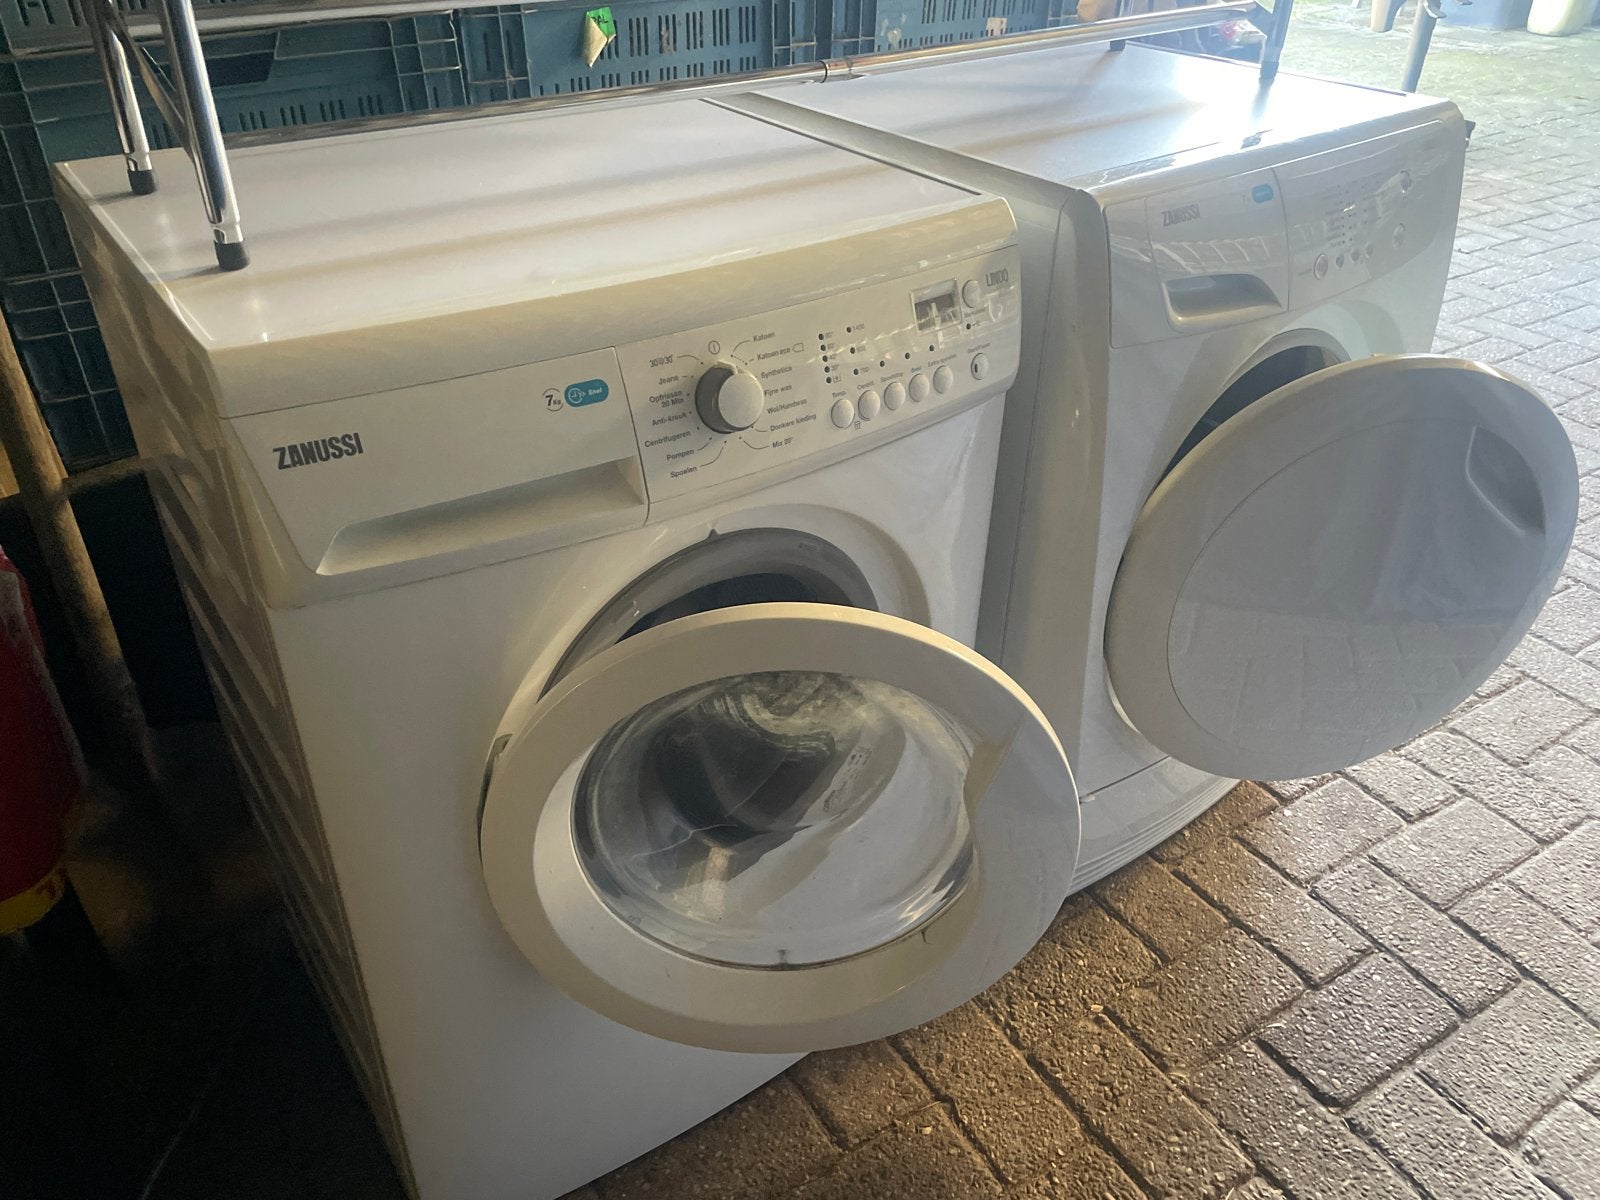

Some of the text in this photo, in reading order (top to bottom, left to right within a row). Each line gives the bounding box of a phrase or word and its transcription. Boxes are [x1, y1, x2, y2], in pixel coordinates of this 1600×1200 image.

[1160, 202, 1201, 227] ZANUSSI
[985, 267, 1010, 287] LINDO
[753, 331, 776, 342] Katoen
[757, 346, 791, 361] Katoen eco
[658, 375, 679, 385] Jeans
[780, 384, 793, 392] was
[769, 419, 795, 432] Donkere
[644, 430, 691, 448] Centrifugeren
[772, 440, 783, 448] Mix
[272, 432, 364, 470] ZANUSSI
[666, 449, 695, 462] Pompen
[670, 465, 698, 479] Spoelen
